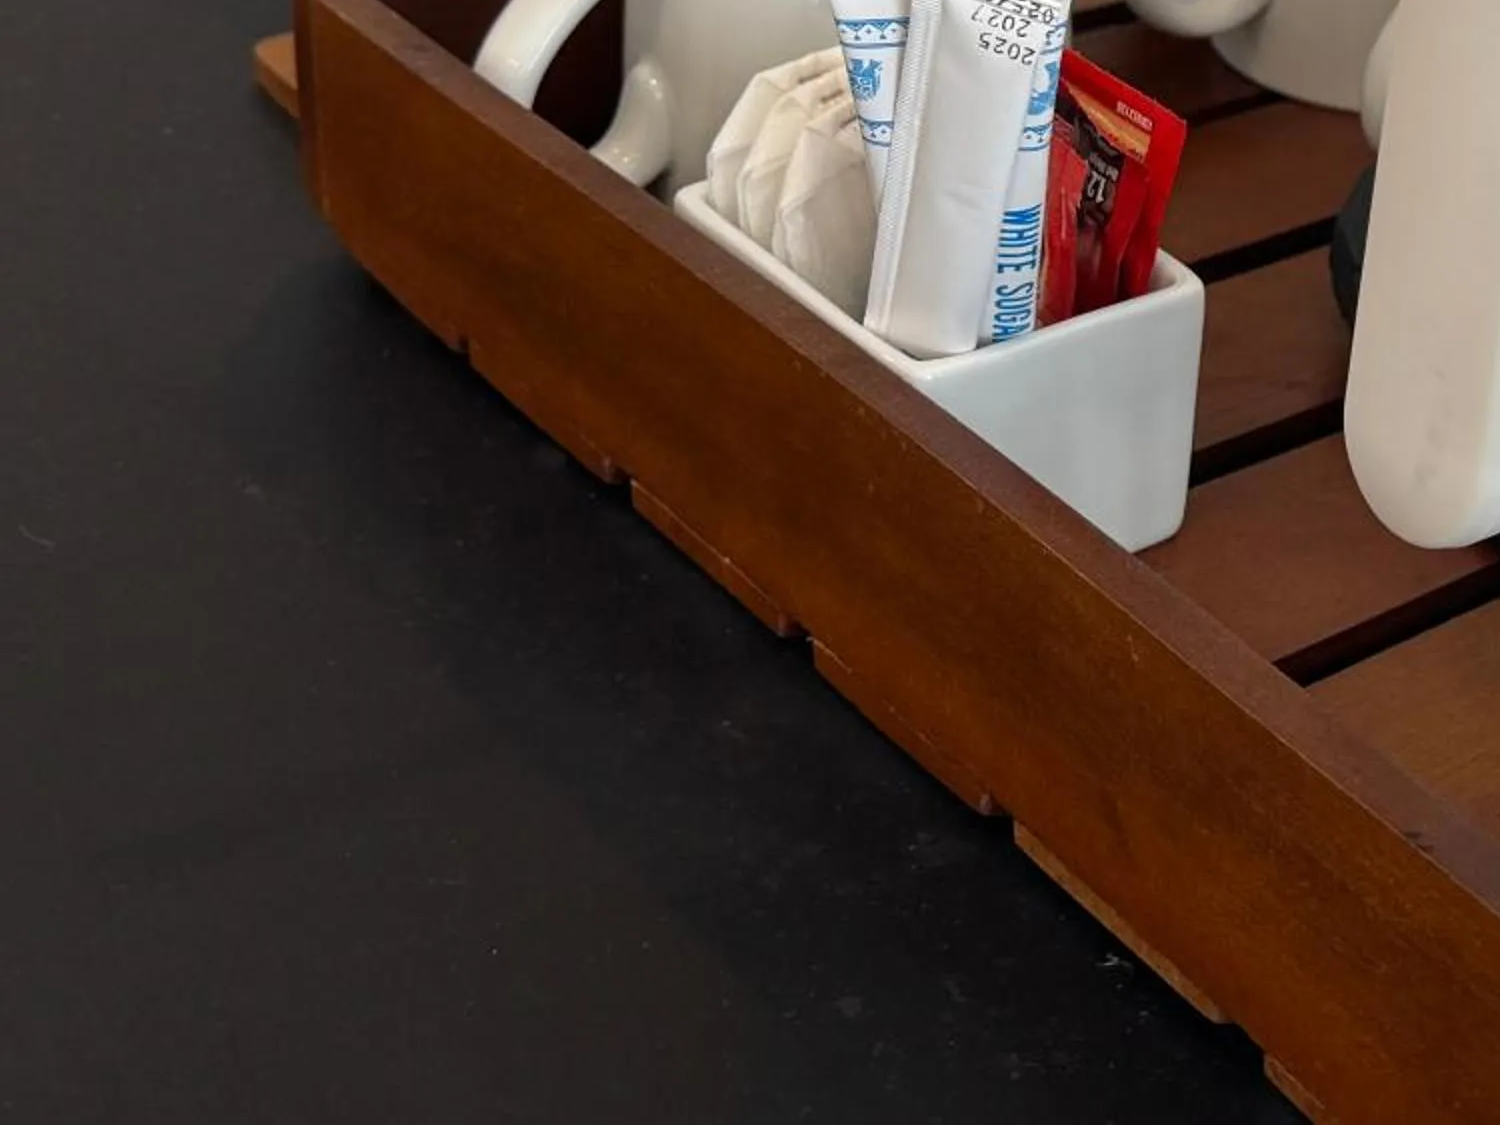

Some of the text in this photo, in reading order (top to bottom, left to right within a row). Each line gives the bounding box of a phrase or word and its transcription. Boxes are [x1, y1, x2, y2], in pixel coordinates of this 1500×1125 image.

[977, 31, 1036, 65] 2025
[991, 202, 1042, 344] WHITE SUGA
